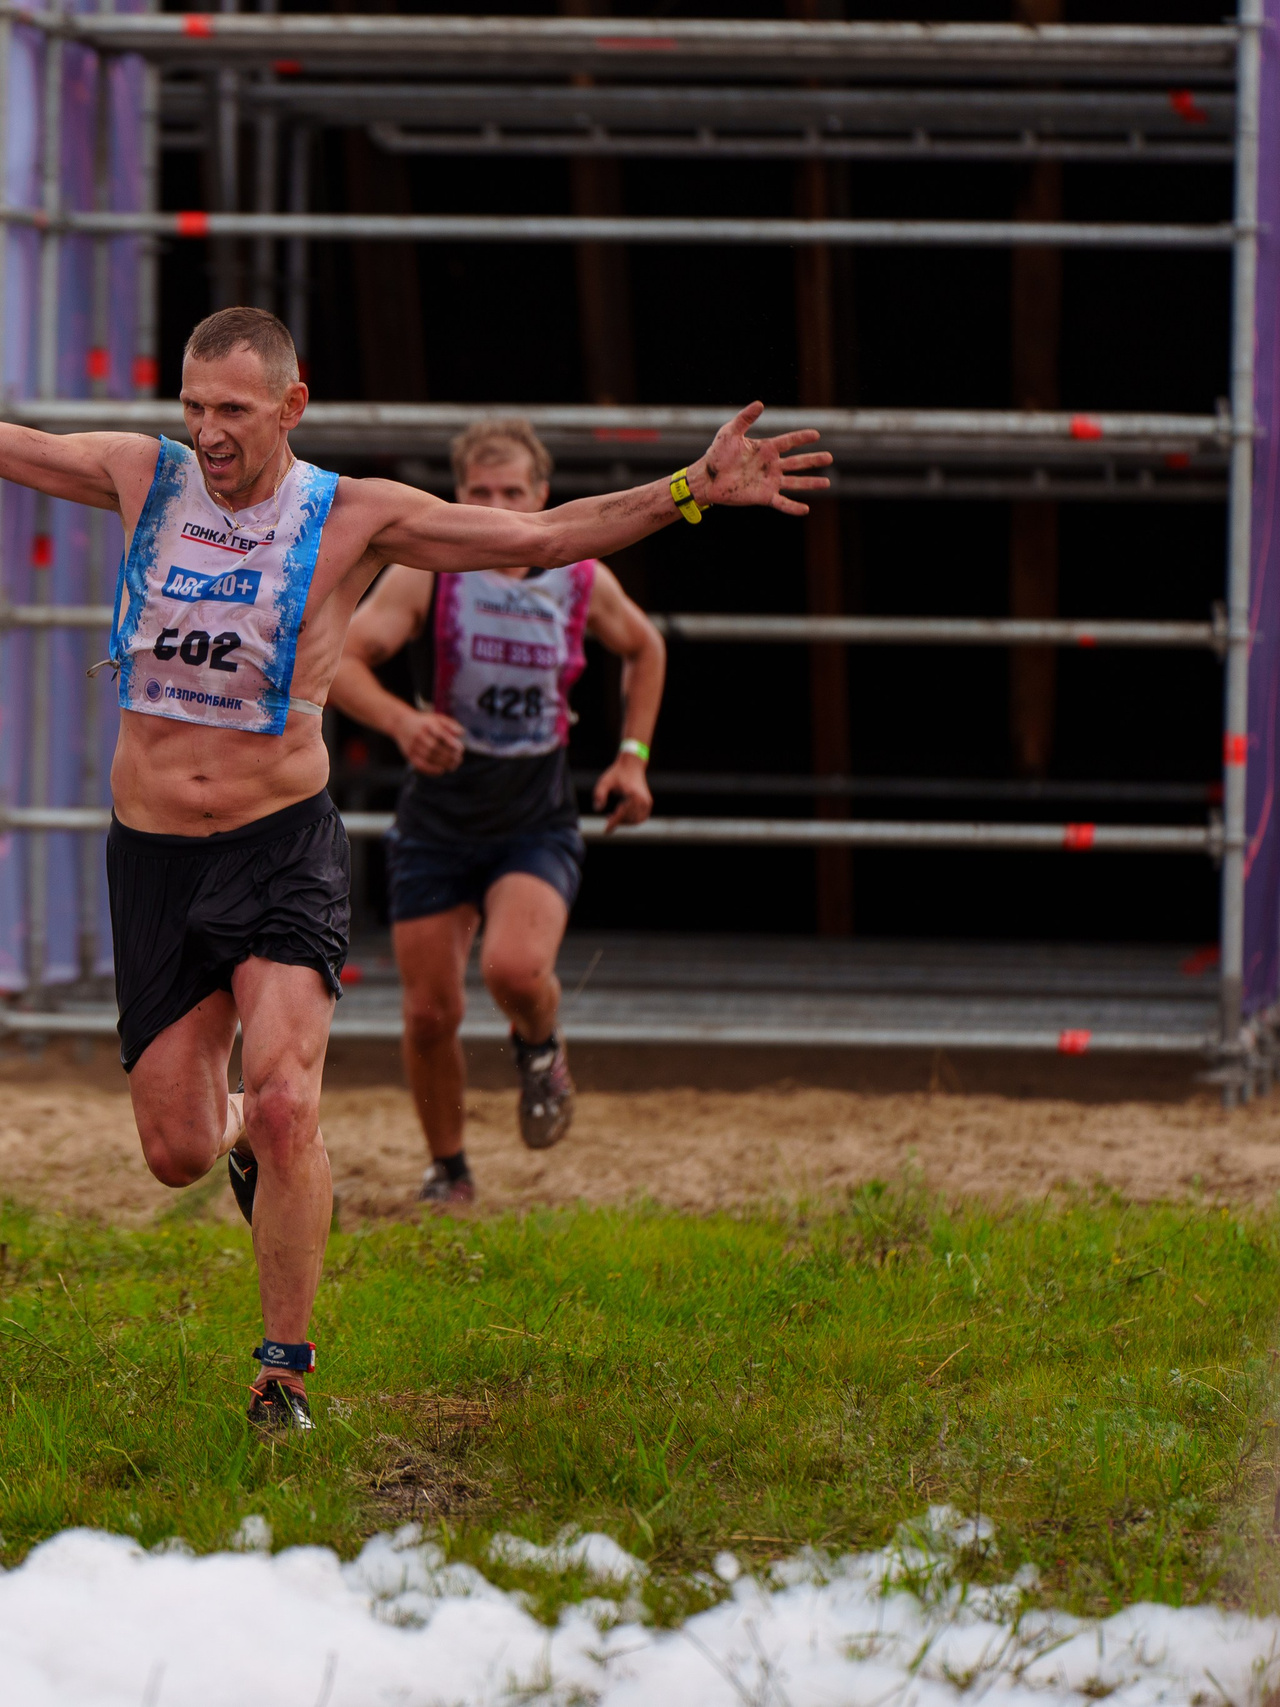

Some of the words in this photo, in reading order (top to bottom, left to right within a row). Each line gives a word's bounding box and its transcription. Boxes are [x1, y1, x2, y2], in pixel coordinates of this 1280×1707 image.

[182, 522, 227, 545] ГОНКА
[230, 530, 275, 551] ГЕРВ
[209, 574, 253, 597] 40+
[152, 627, 242, 673] 602
[164, 686, 243, 711] ГАЗПРОМБАНК
[477, 684, 543, 721] 428
